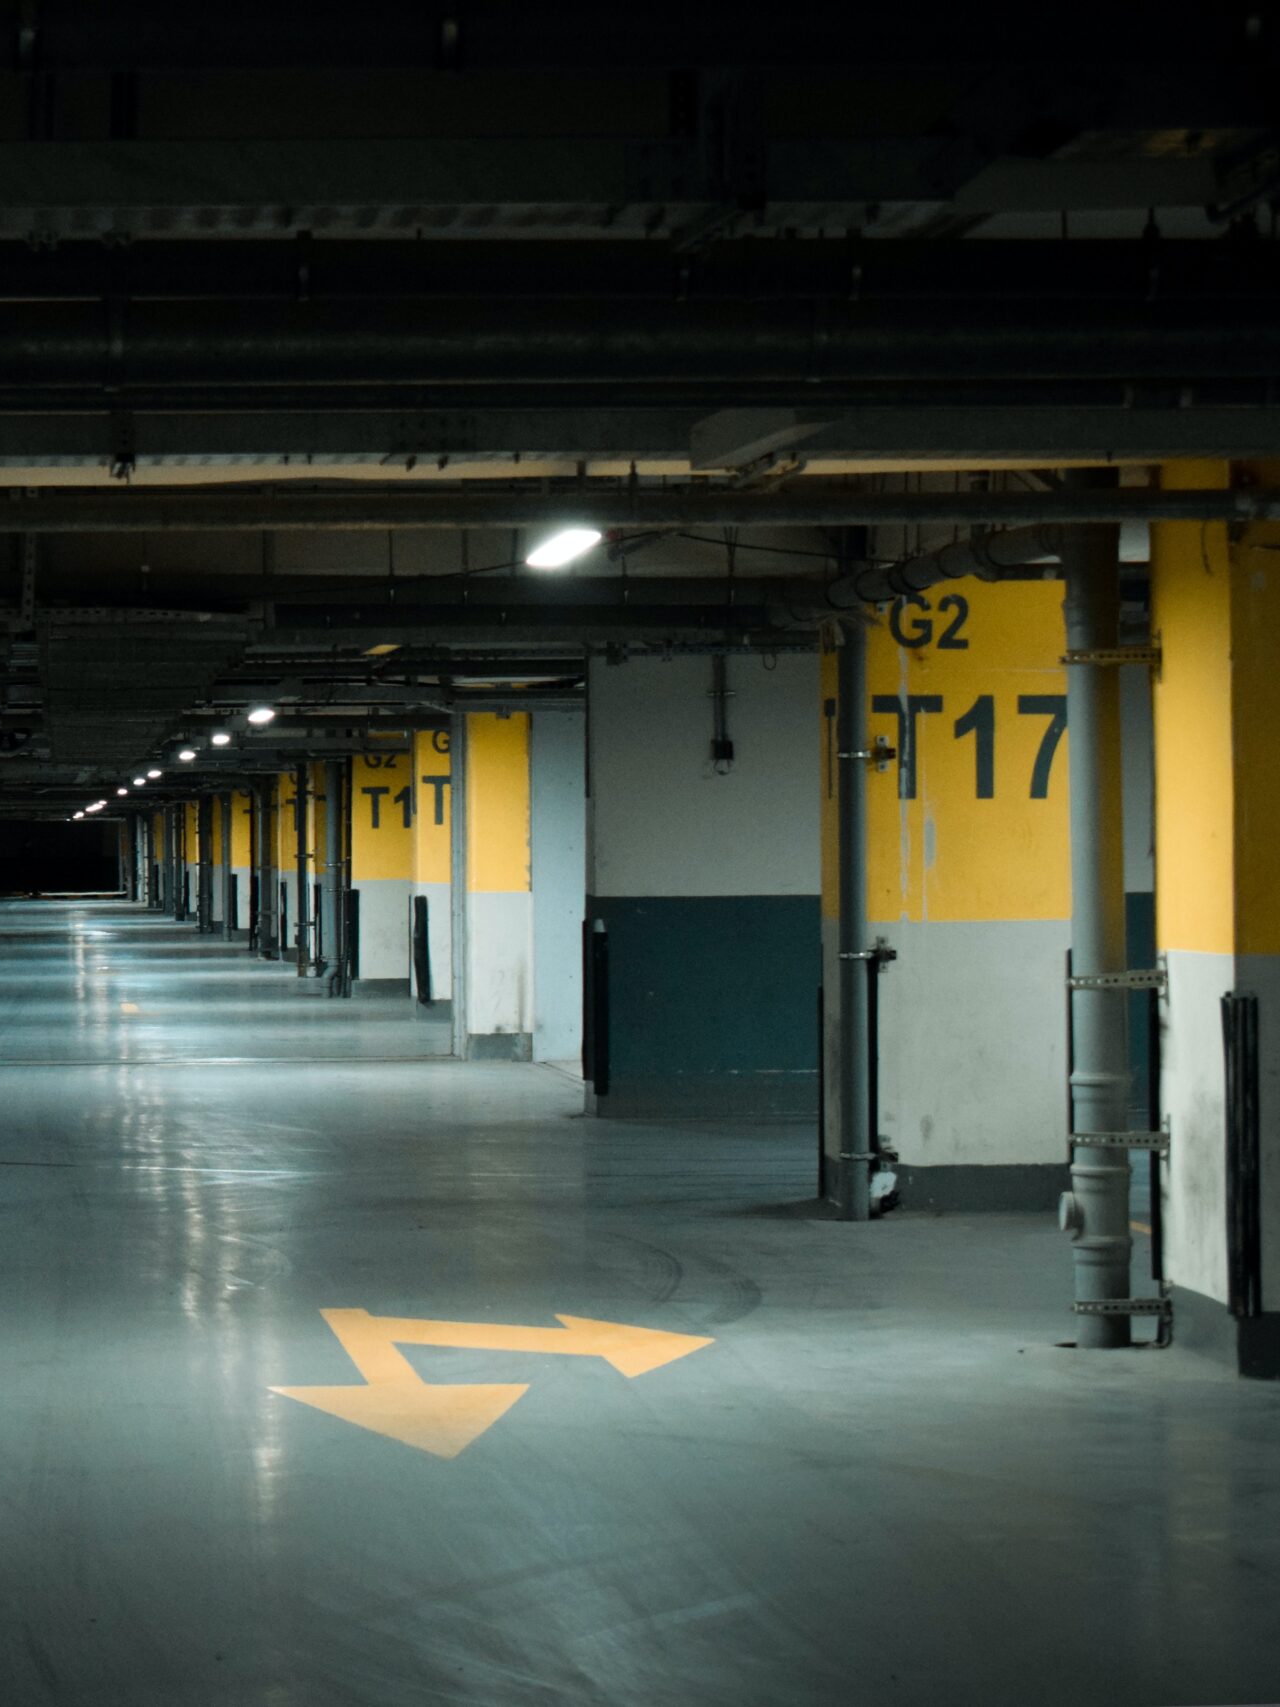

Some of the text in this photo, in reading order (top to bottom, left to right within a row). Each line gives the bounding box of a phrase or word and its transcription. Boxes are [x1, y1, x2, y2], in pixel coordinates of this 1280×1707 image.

[890, 594, 969, 649] G2
[432, 730, 449, 753] G
[872, 695, 1068, 799] T17
[361, 786, 411, 828] T1
[422, 776, 451, 825] T
